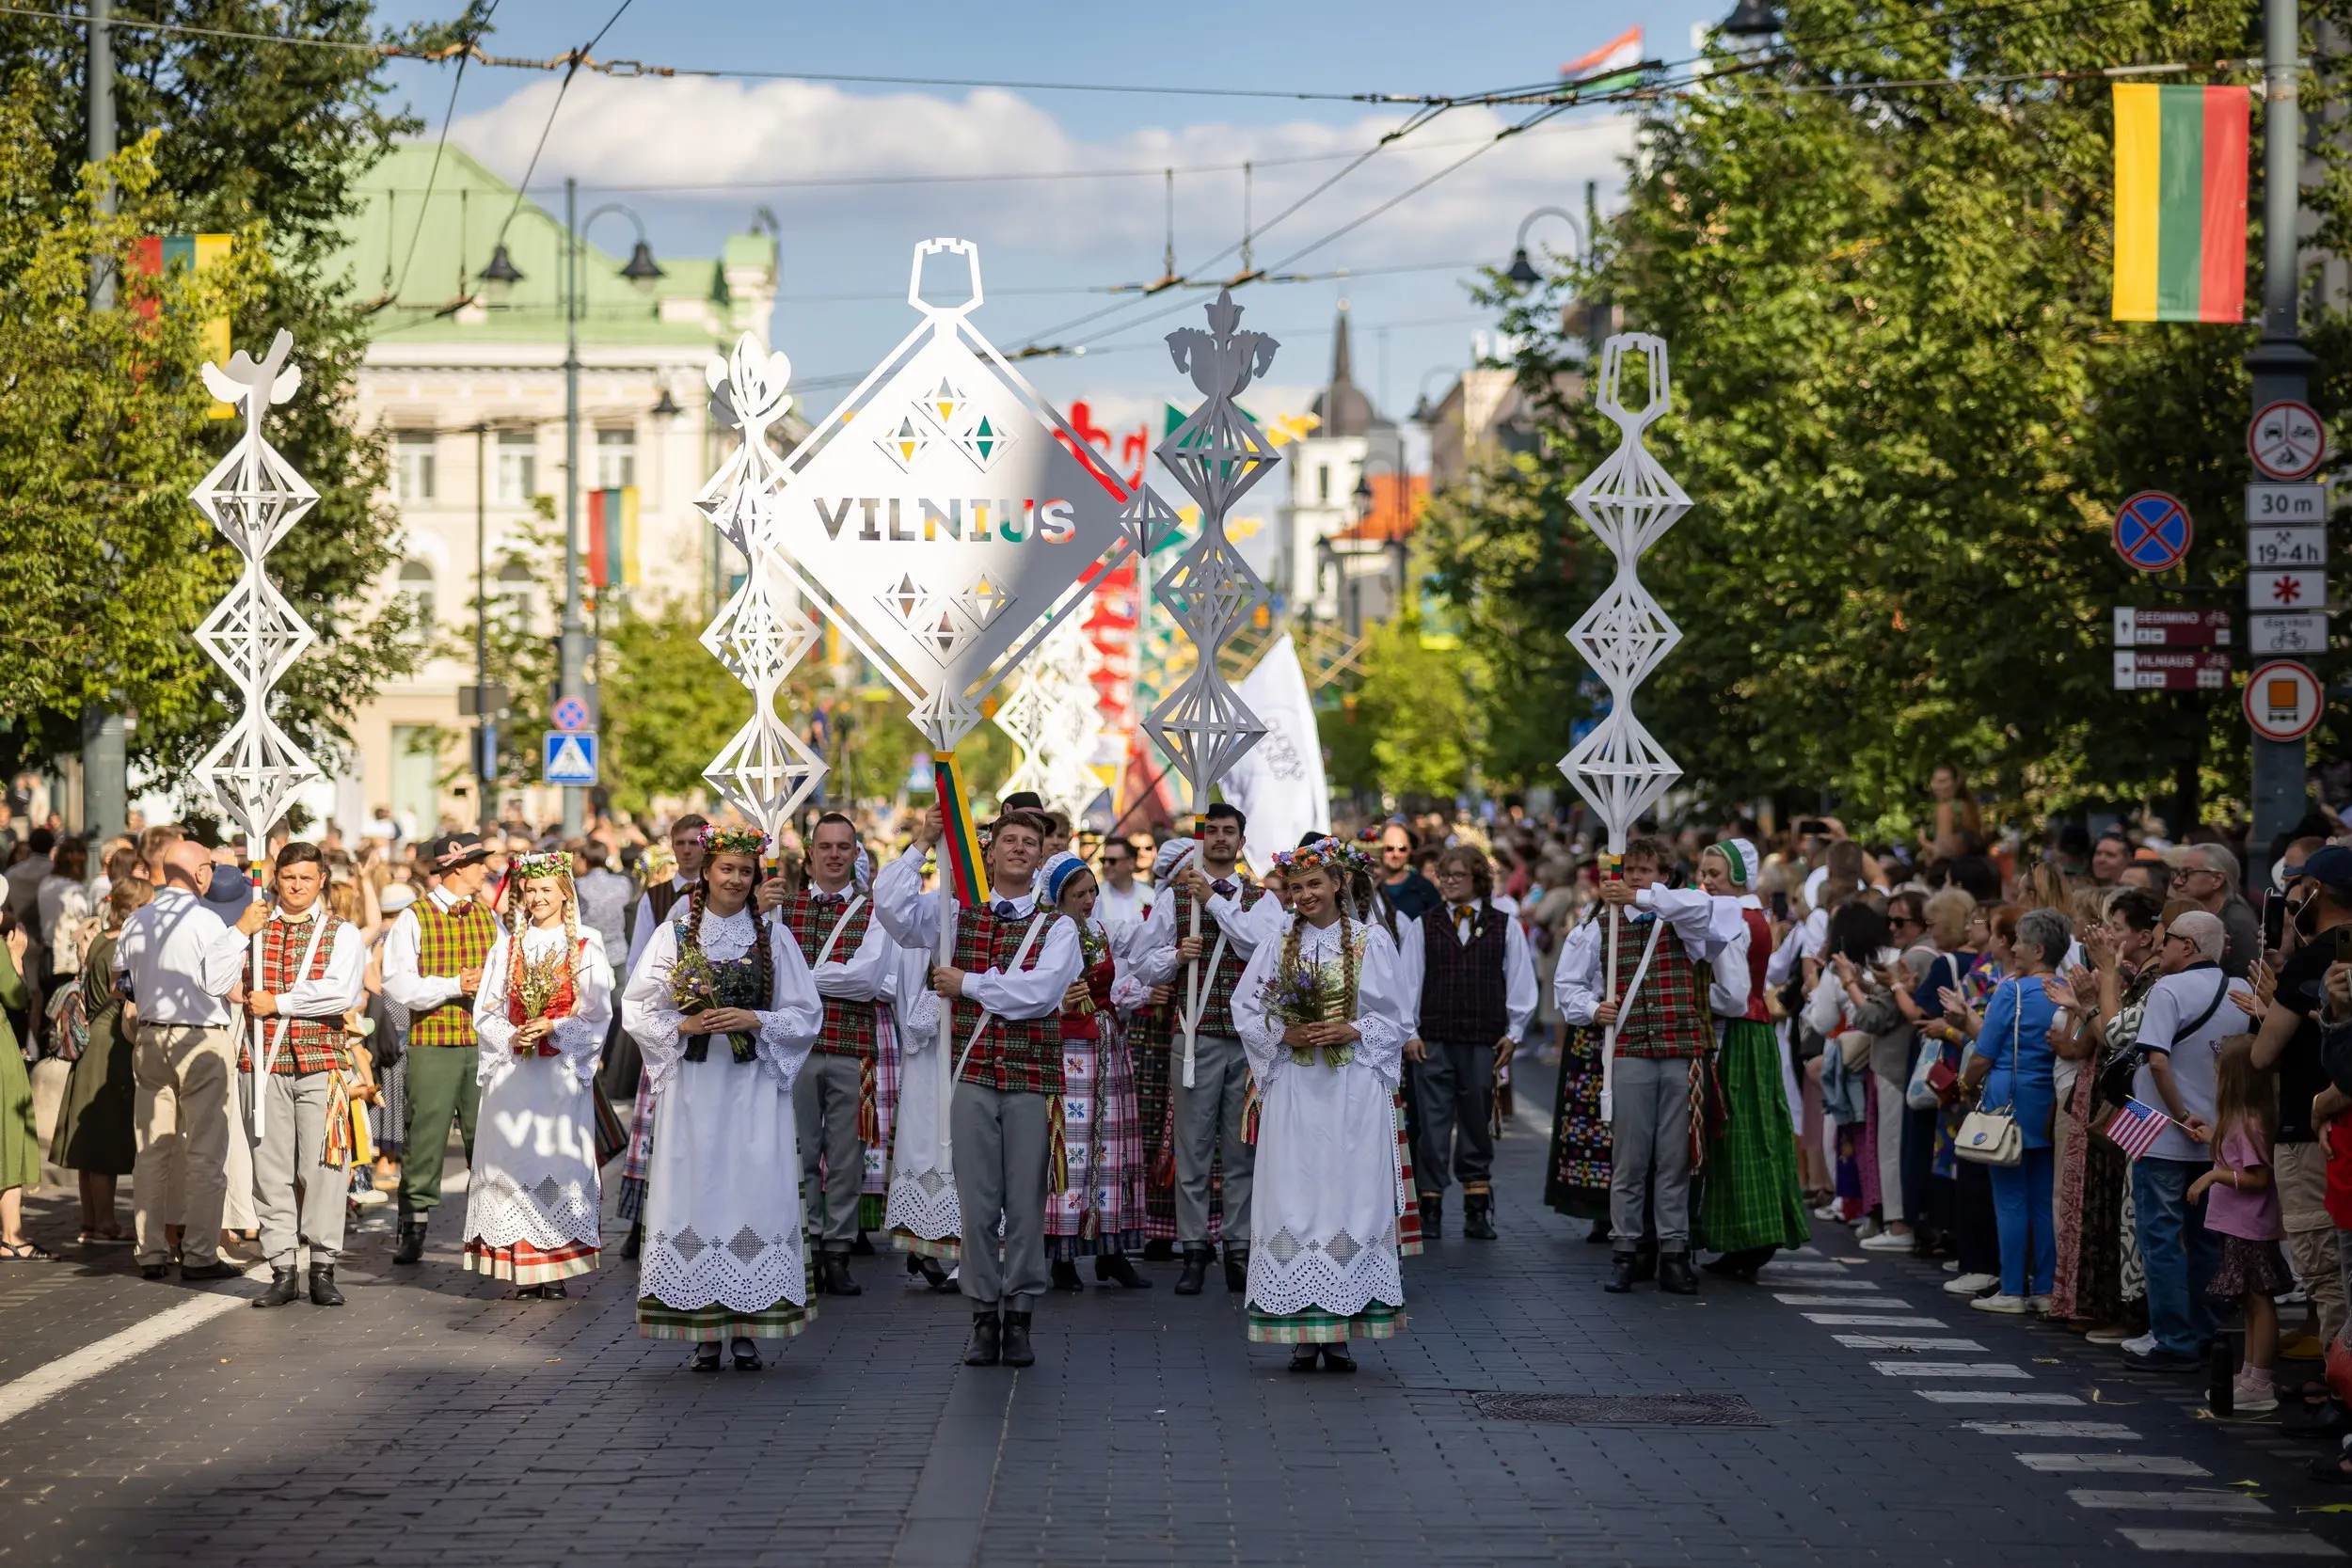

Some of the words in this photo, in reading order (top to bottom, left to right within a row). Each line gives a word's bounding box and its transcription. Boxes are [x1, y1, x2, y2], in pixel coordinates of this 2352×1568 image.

[2261, 494, 2288, 515] 30
[2295, 498, 2312, 514] m
[813, 498, 1075, 544] VILNIUS
[2258, 544, 2302, 562] 19-4
[2307, 544, 2319, 562] h
[2136, 655, 2196, 668] VILNIAUS
